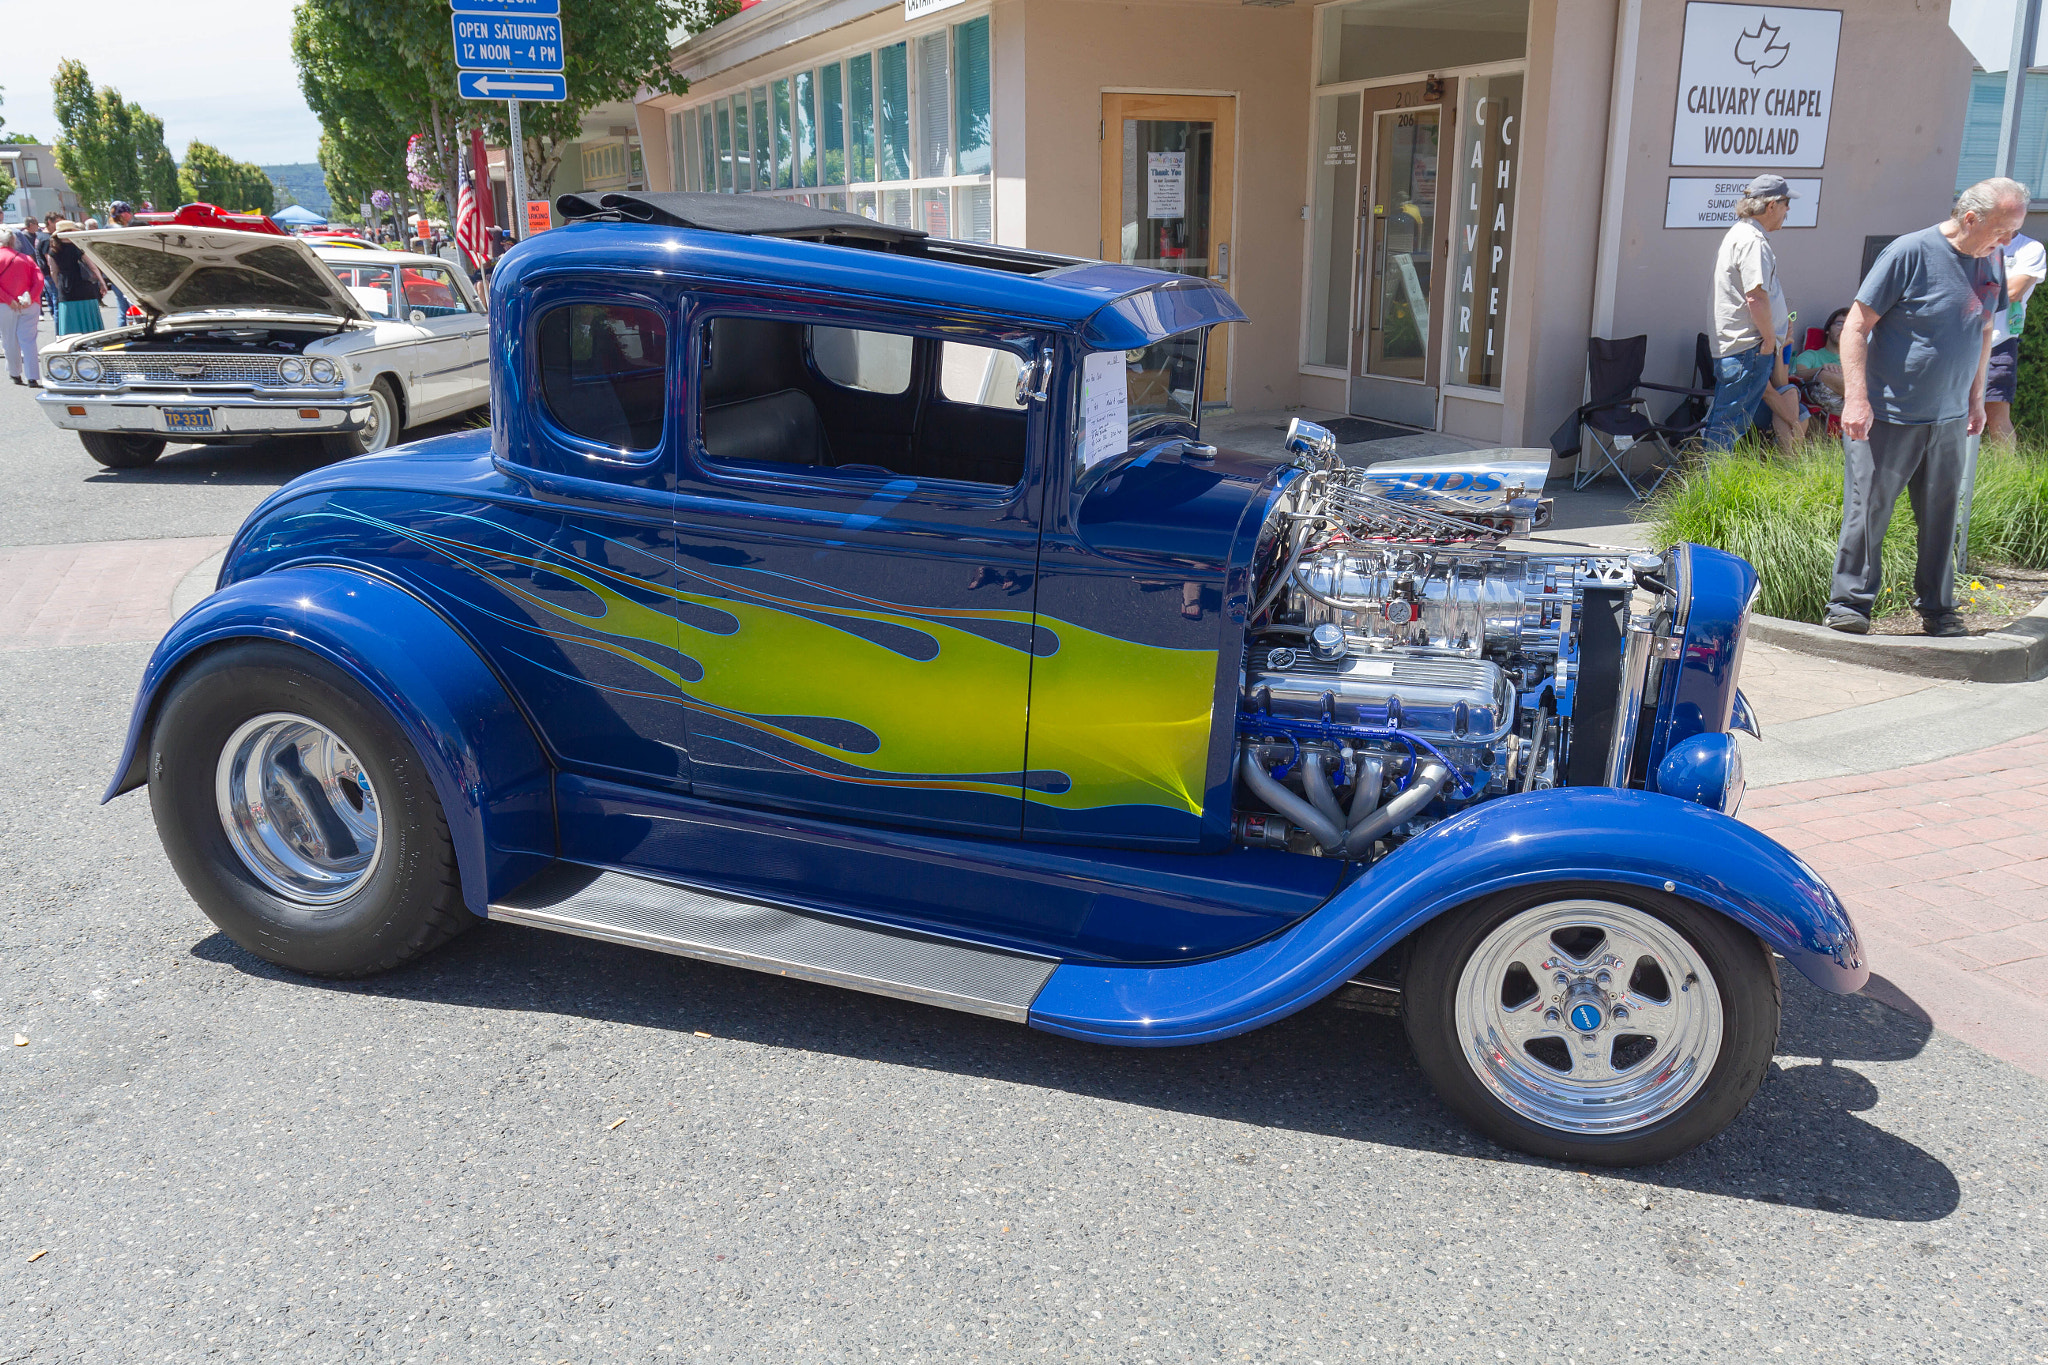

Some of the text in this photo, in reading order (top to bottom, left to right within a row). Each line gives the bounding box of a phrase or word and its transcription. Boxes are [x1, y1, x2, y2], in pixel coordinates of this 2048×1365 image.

[459, 22, 557, 41] OPEN SATURDAYS
[463, 43, 476, 60] 12
[479, 44, 511, 60] NOON
[528, 46, 536, 61] 4
[540, 46, 556, 62] PM
[1687, 85, 1822, 117] CALVARY CHAPEL
[1398, 114, 1414, 127] 206
[1705, 126, 1799, 155] WOODLAND
[1708, 200, 1737, 209] SUNDA
[1458, 97, 1486, 373] CALVARY
[1486, 116, 1513, 356] CHAPEL
[165, 413, 212, 425] 7P-3371
[1388, 473, 1509, 492] BDS
[1385, 492, 1493, 503] Racing
